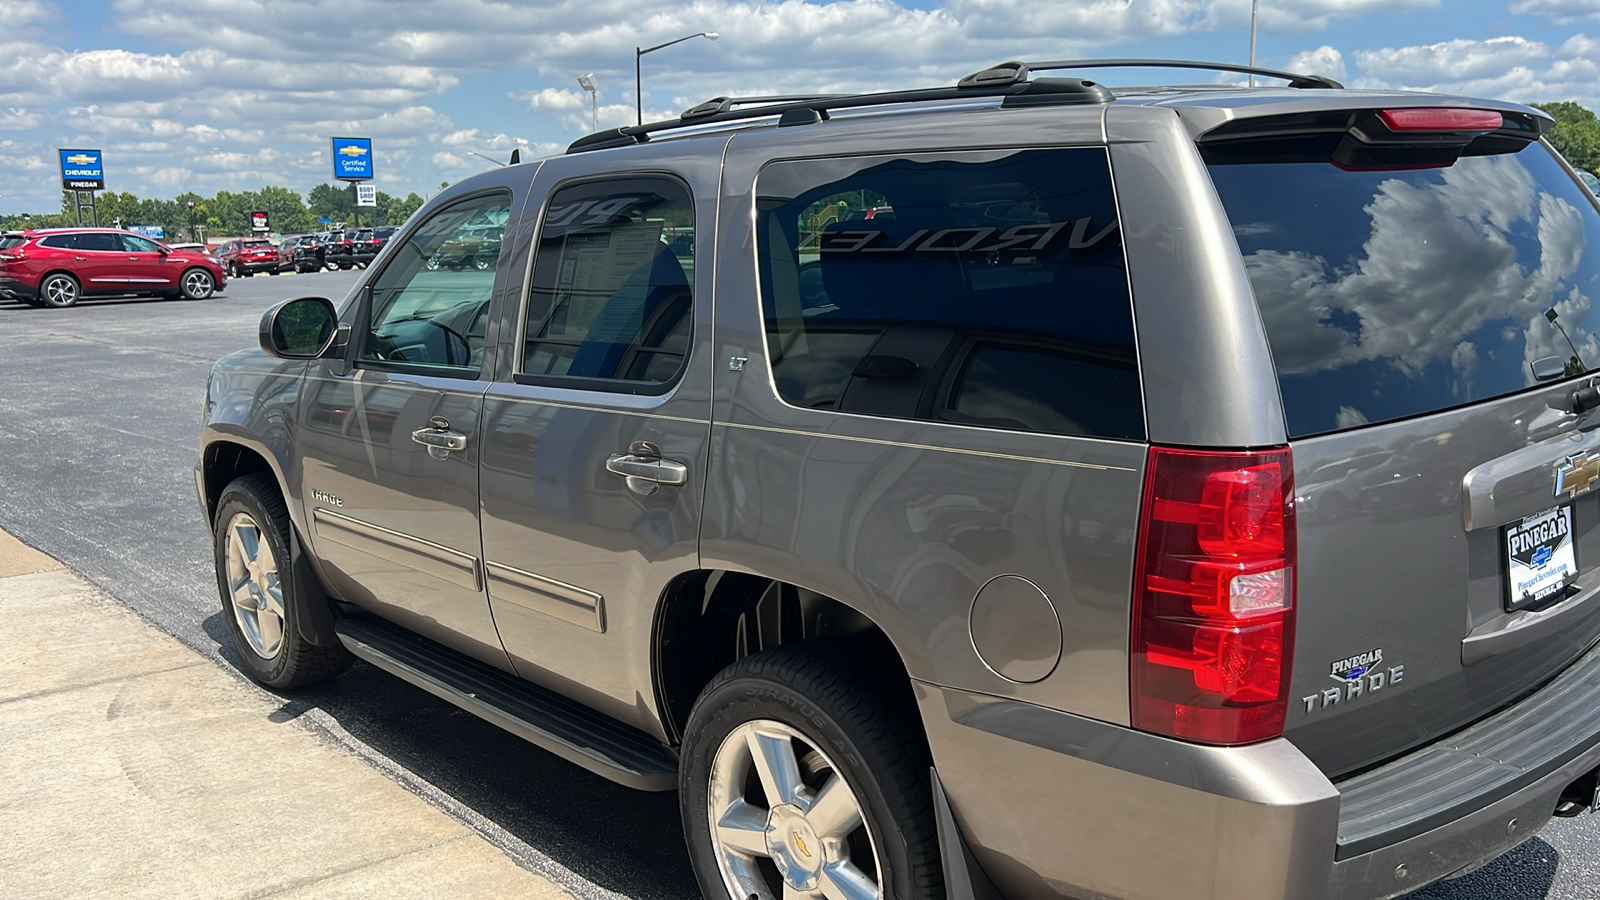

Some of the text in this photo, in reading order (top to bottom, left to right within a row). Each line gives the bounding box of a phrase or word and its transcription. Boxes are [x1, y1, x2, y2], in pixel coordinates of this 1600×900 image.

[341, 159, 366, 167] Certified
[729, 356, 748, 371] LT
[311, 488, 344, 507] TAHOE
[1511, 516, 1567, 556] PINEGAR
[1331, 648, 1383, 675] PINEGAR
[1302, 665, 1404, 714] TAHOE
[745, 685, 827, 729] STRATUS
